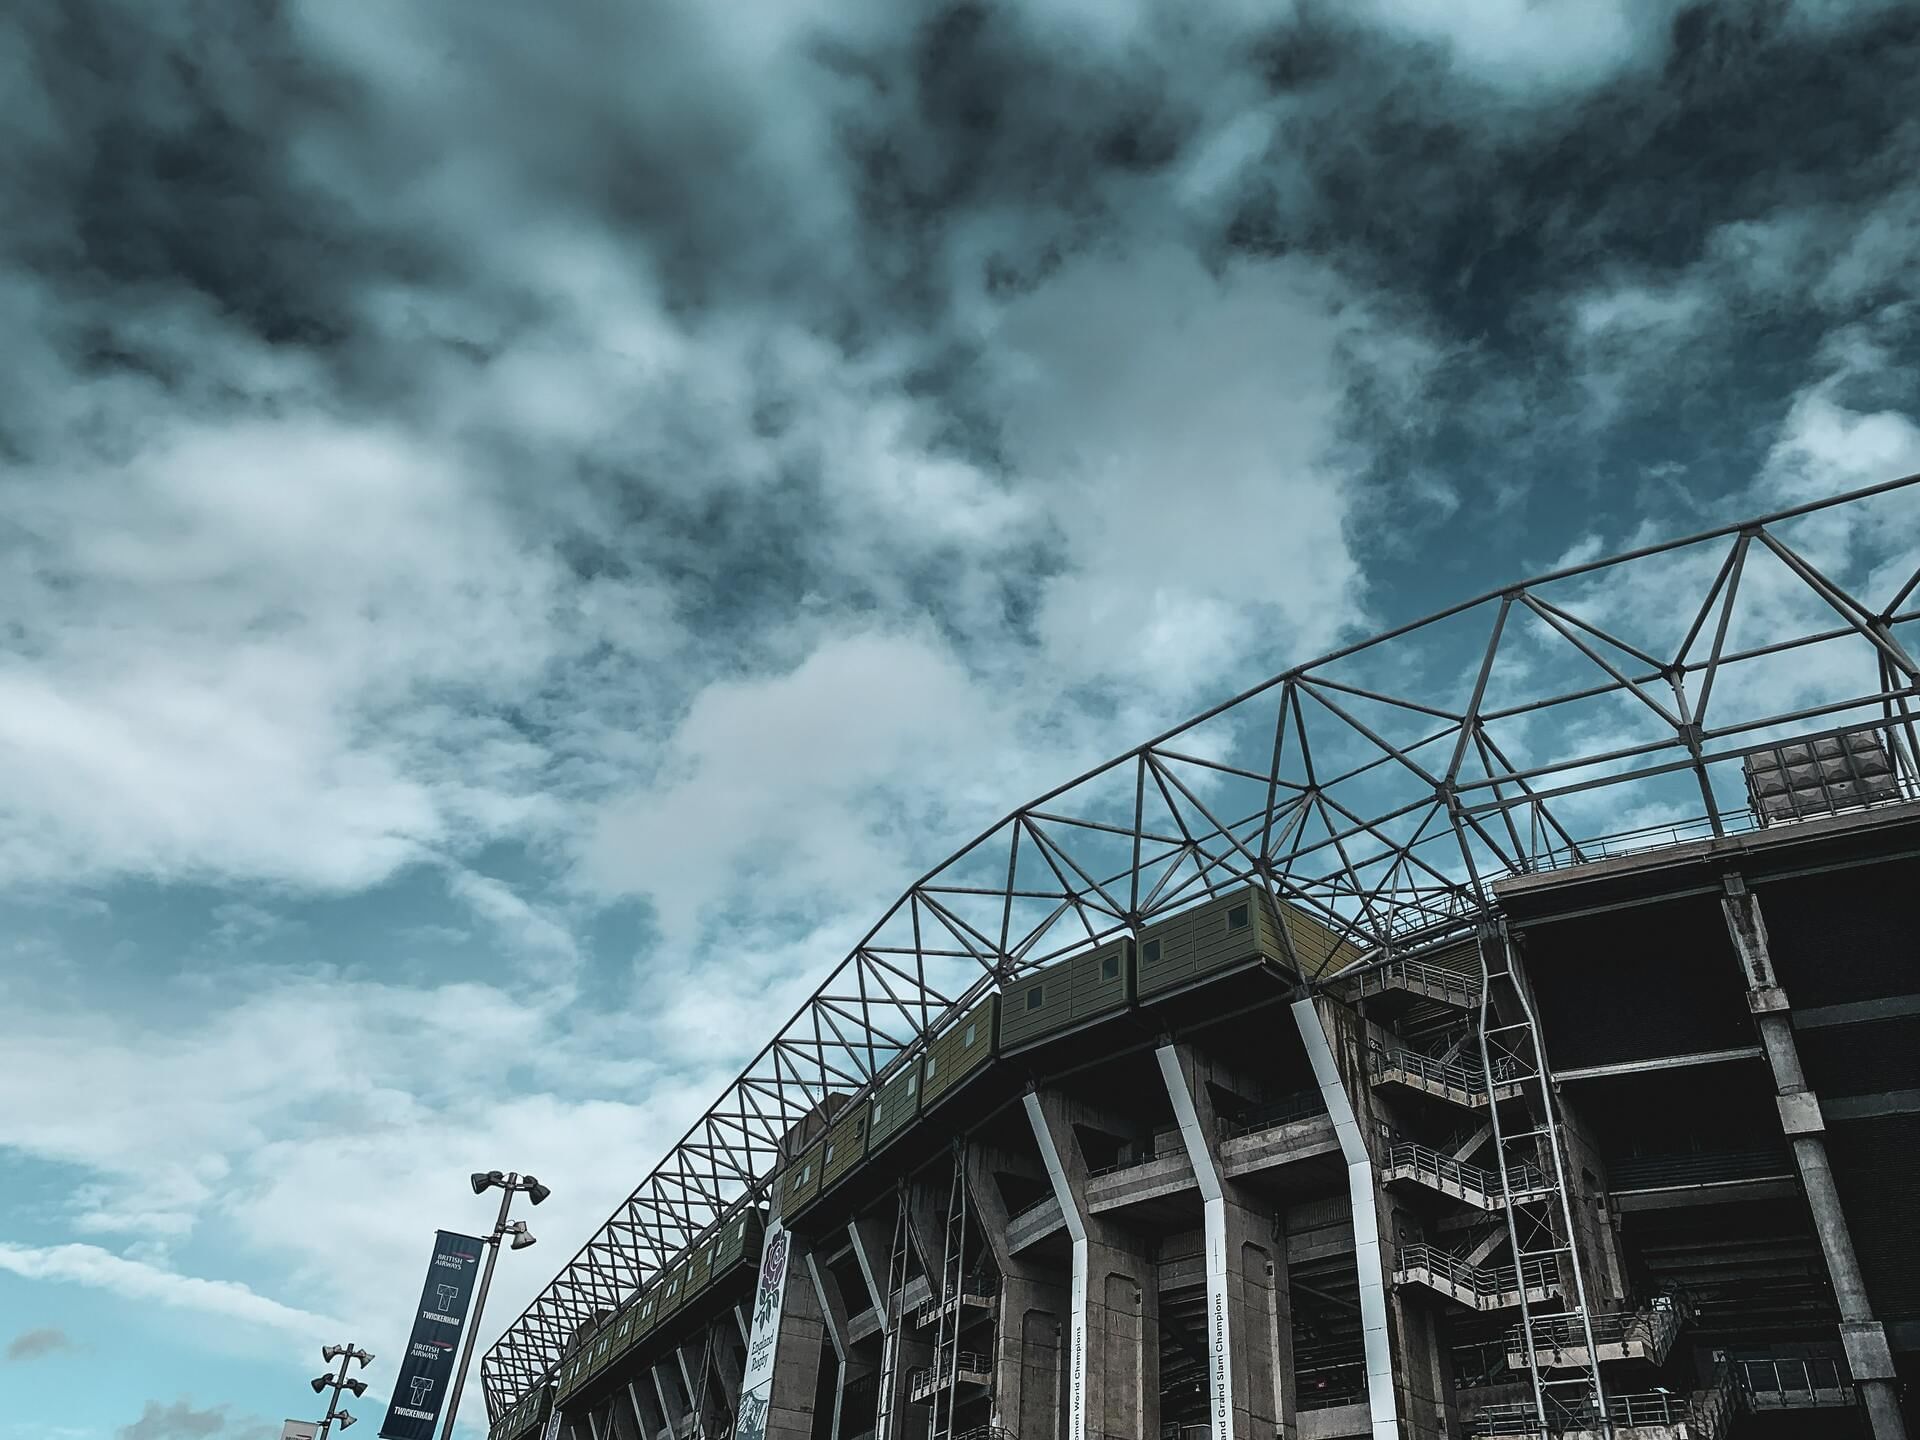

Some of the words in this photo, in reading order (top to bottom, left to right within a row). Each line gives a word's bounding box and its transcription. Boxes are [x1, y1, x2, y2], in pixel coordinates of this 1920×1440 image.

[434, 1259, 462, 1270] AIRWAYS
[438, 1254, 463, 1265] BRITISH
[423, 1311, 460, 1326] TWICKENHAM
[1214, 1293, 1223, 1353] Champions
[414, 1343, 439, 1354] BRITISH
[752, 1329, 774, 1355] England
[411, 1350, 438, 1361] AIRWAYS
[751, 1351, 769, 1372] Rugby
[1074, 1326, 1082, 1380] Champions
[1216, 1354, 1224, 1380] Slam
[1217, 1384, 1226, 1418] Grand
[394, 1406, 434, 1421] TWICKENHAM
